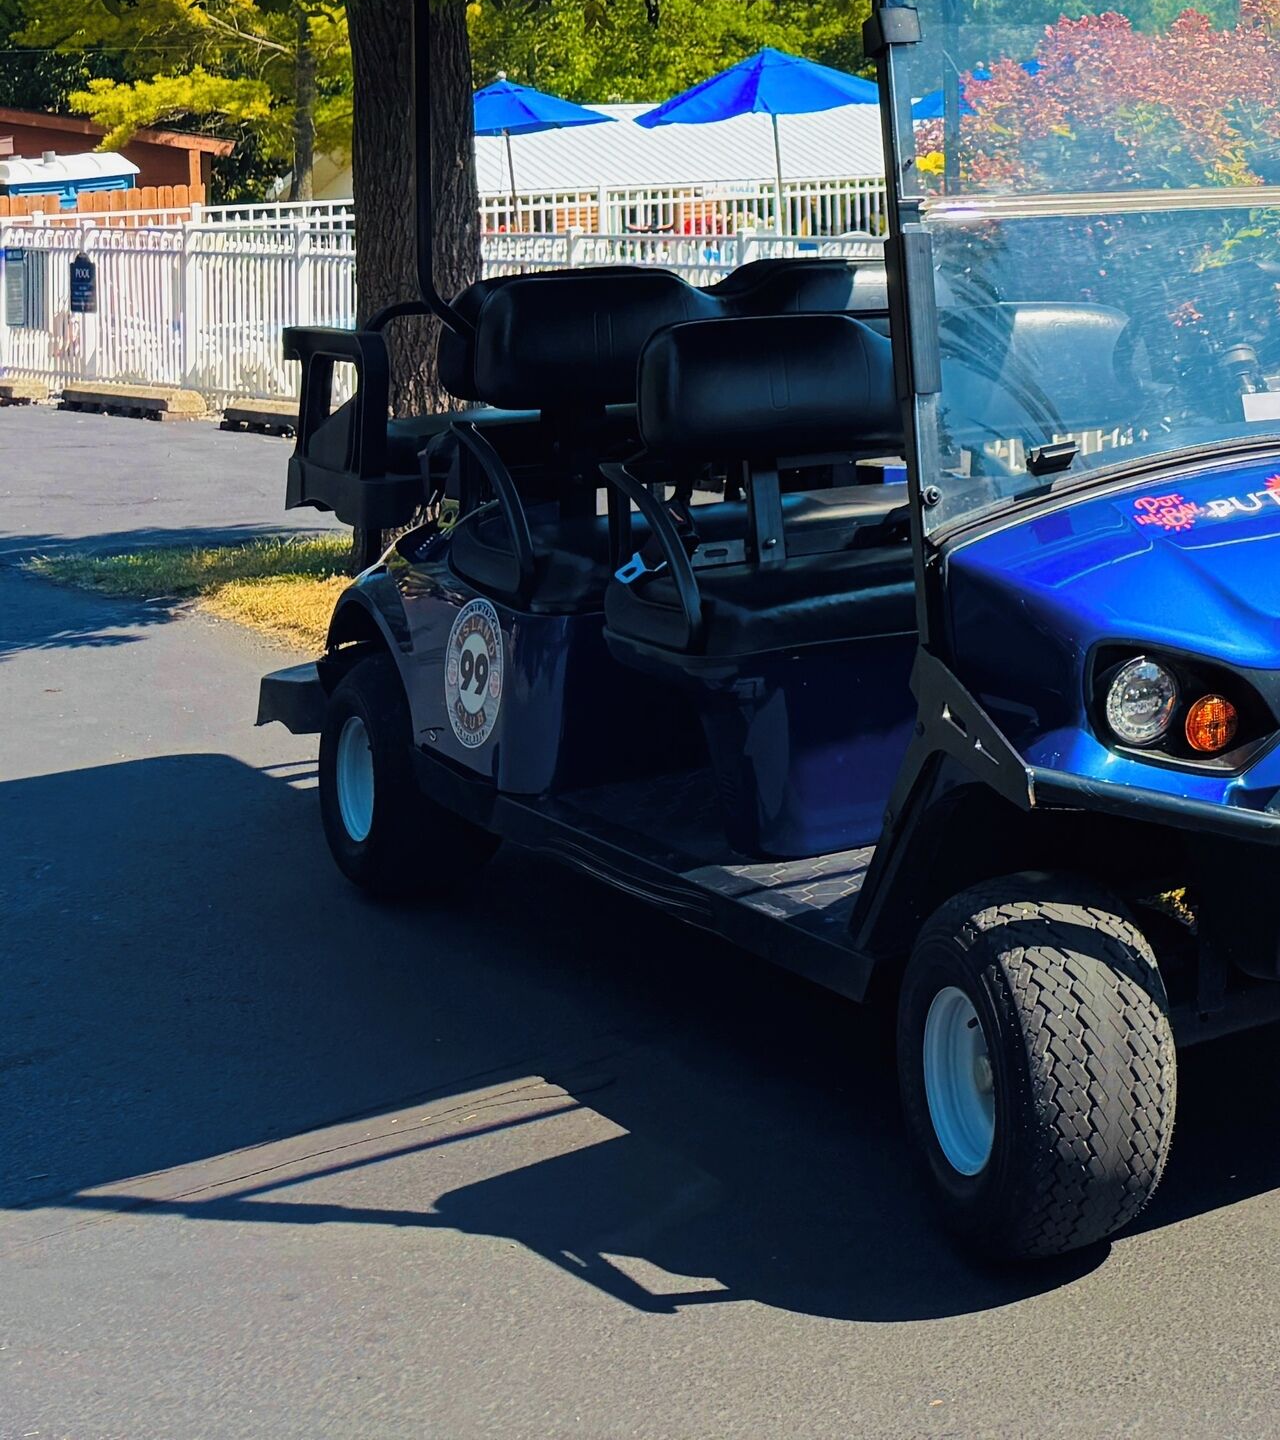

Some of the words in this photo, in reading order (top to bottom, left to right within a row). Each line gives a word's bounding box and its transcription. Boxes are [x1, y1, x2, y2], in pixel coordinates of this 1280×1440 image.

[75, 268, 90, 279] POOL
[457, 618, 496, 658] ISLAND
[460, 649, 489, 696] 99
[456, 703, 486, 730] CLUB
